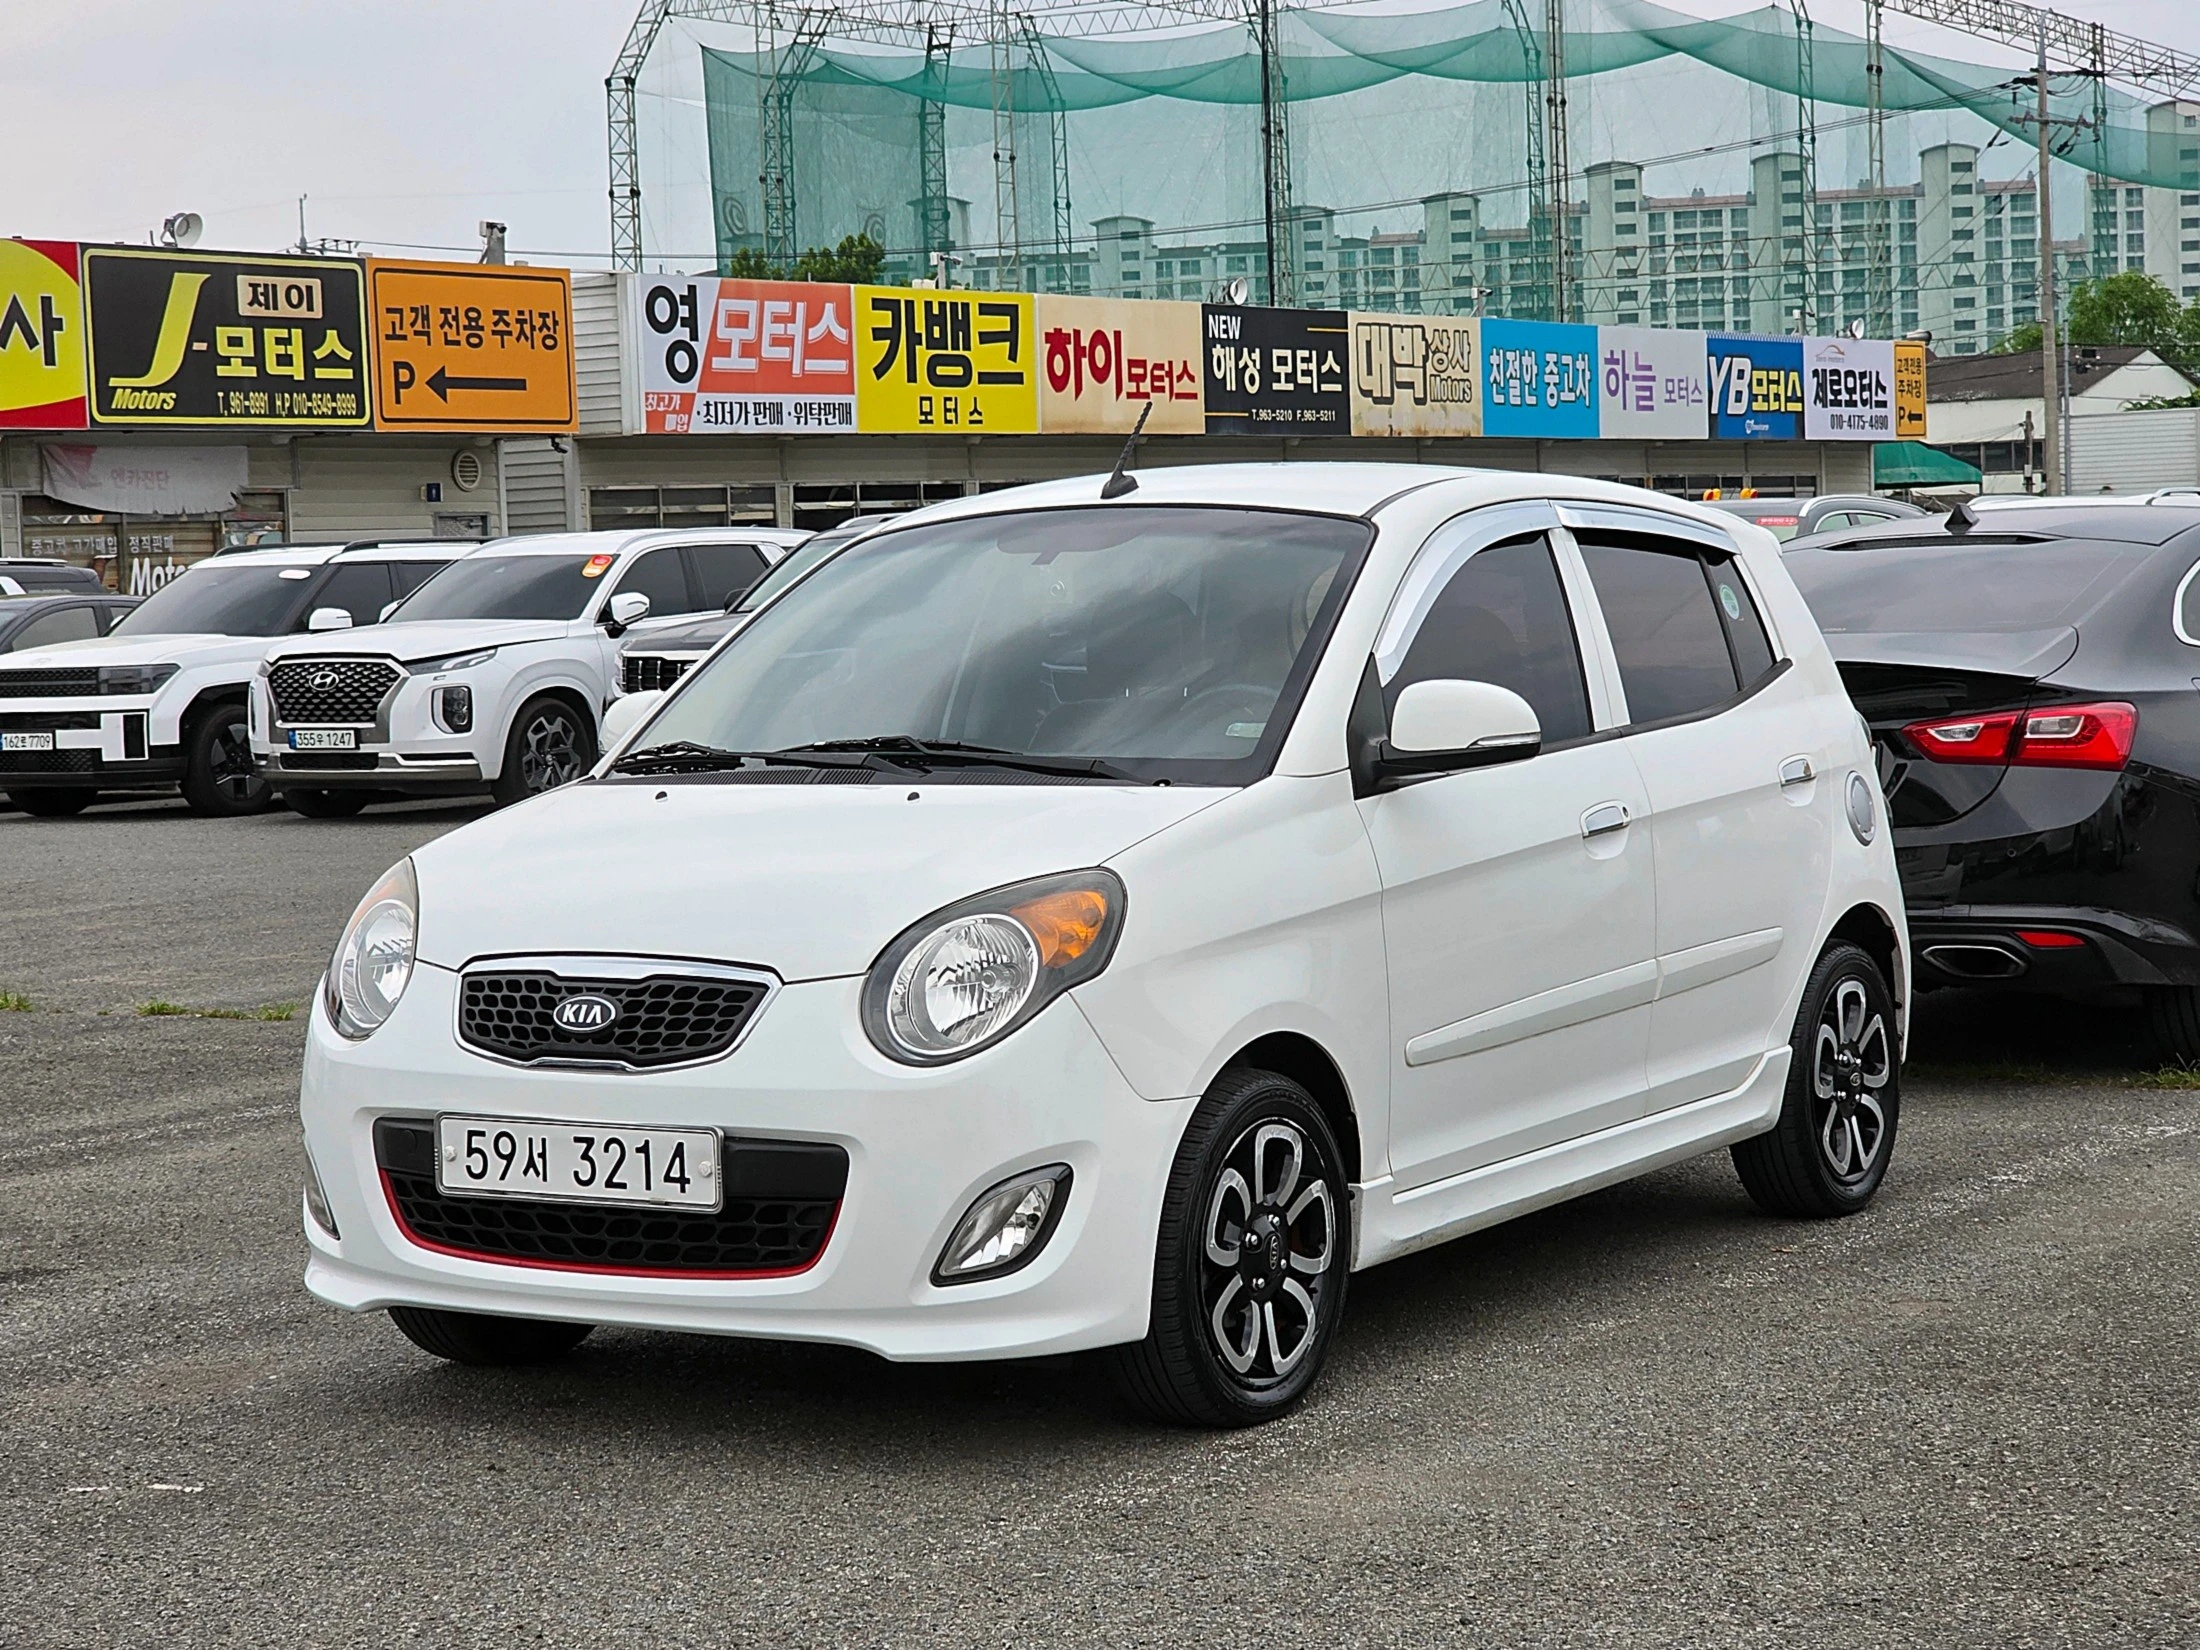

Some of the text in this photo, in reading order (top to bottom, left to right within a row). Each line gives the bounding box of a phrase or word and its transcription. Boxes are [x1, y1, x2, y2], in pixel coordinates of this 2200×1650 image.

[247, 283, 316, 312] 제이
[384, 305, 560, 352] 고객 전용 주차장
[644, 284, 850, 384] 영 모터스
[1208, 314, 1241, 341] NEW
[871, 297, 1026, 389] 카뱅크
[1430, 329, 1471, 373] 상사
[393, 362, 415, 404] P
[1211, 344, 1343, 394] 해성 모터스
[1488, 347, 1592, 408] 친절한 중고차
[1604, 350, 1703, 412] 하늘 모터스
[111, 388, 177, 410] Motors
[230, 391, 269, 414] 961-8991
[1430, 373, 1472, 403] Motors
[1898, 379, 1923, 399] 주차장
[918, 396, 983, 426] 모터스
[1830, 414, 1888, 431] 010-4175-4890
[1898, 406, 1905, 427] P
[326, 732, 352, 746] 1247
[562, 1002, 602, 1025] KIA
[464, 1129, 691, 1194] 59서 3214
